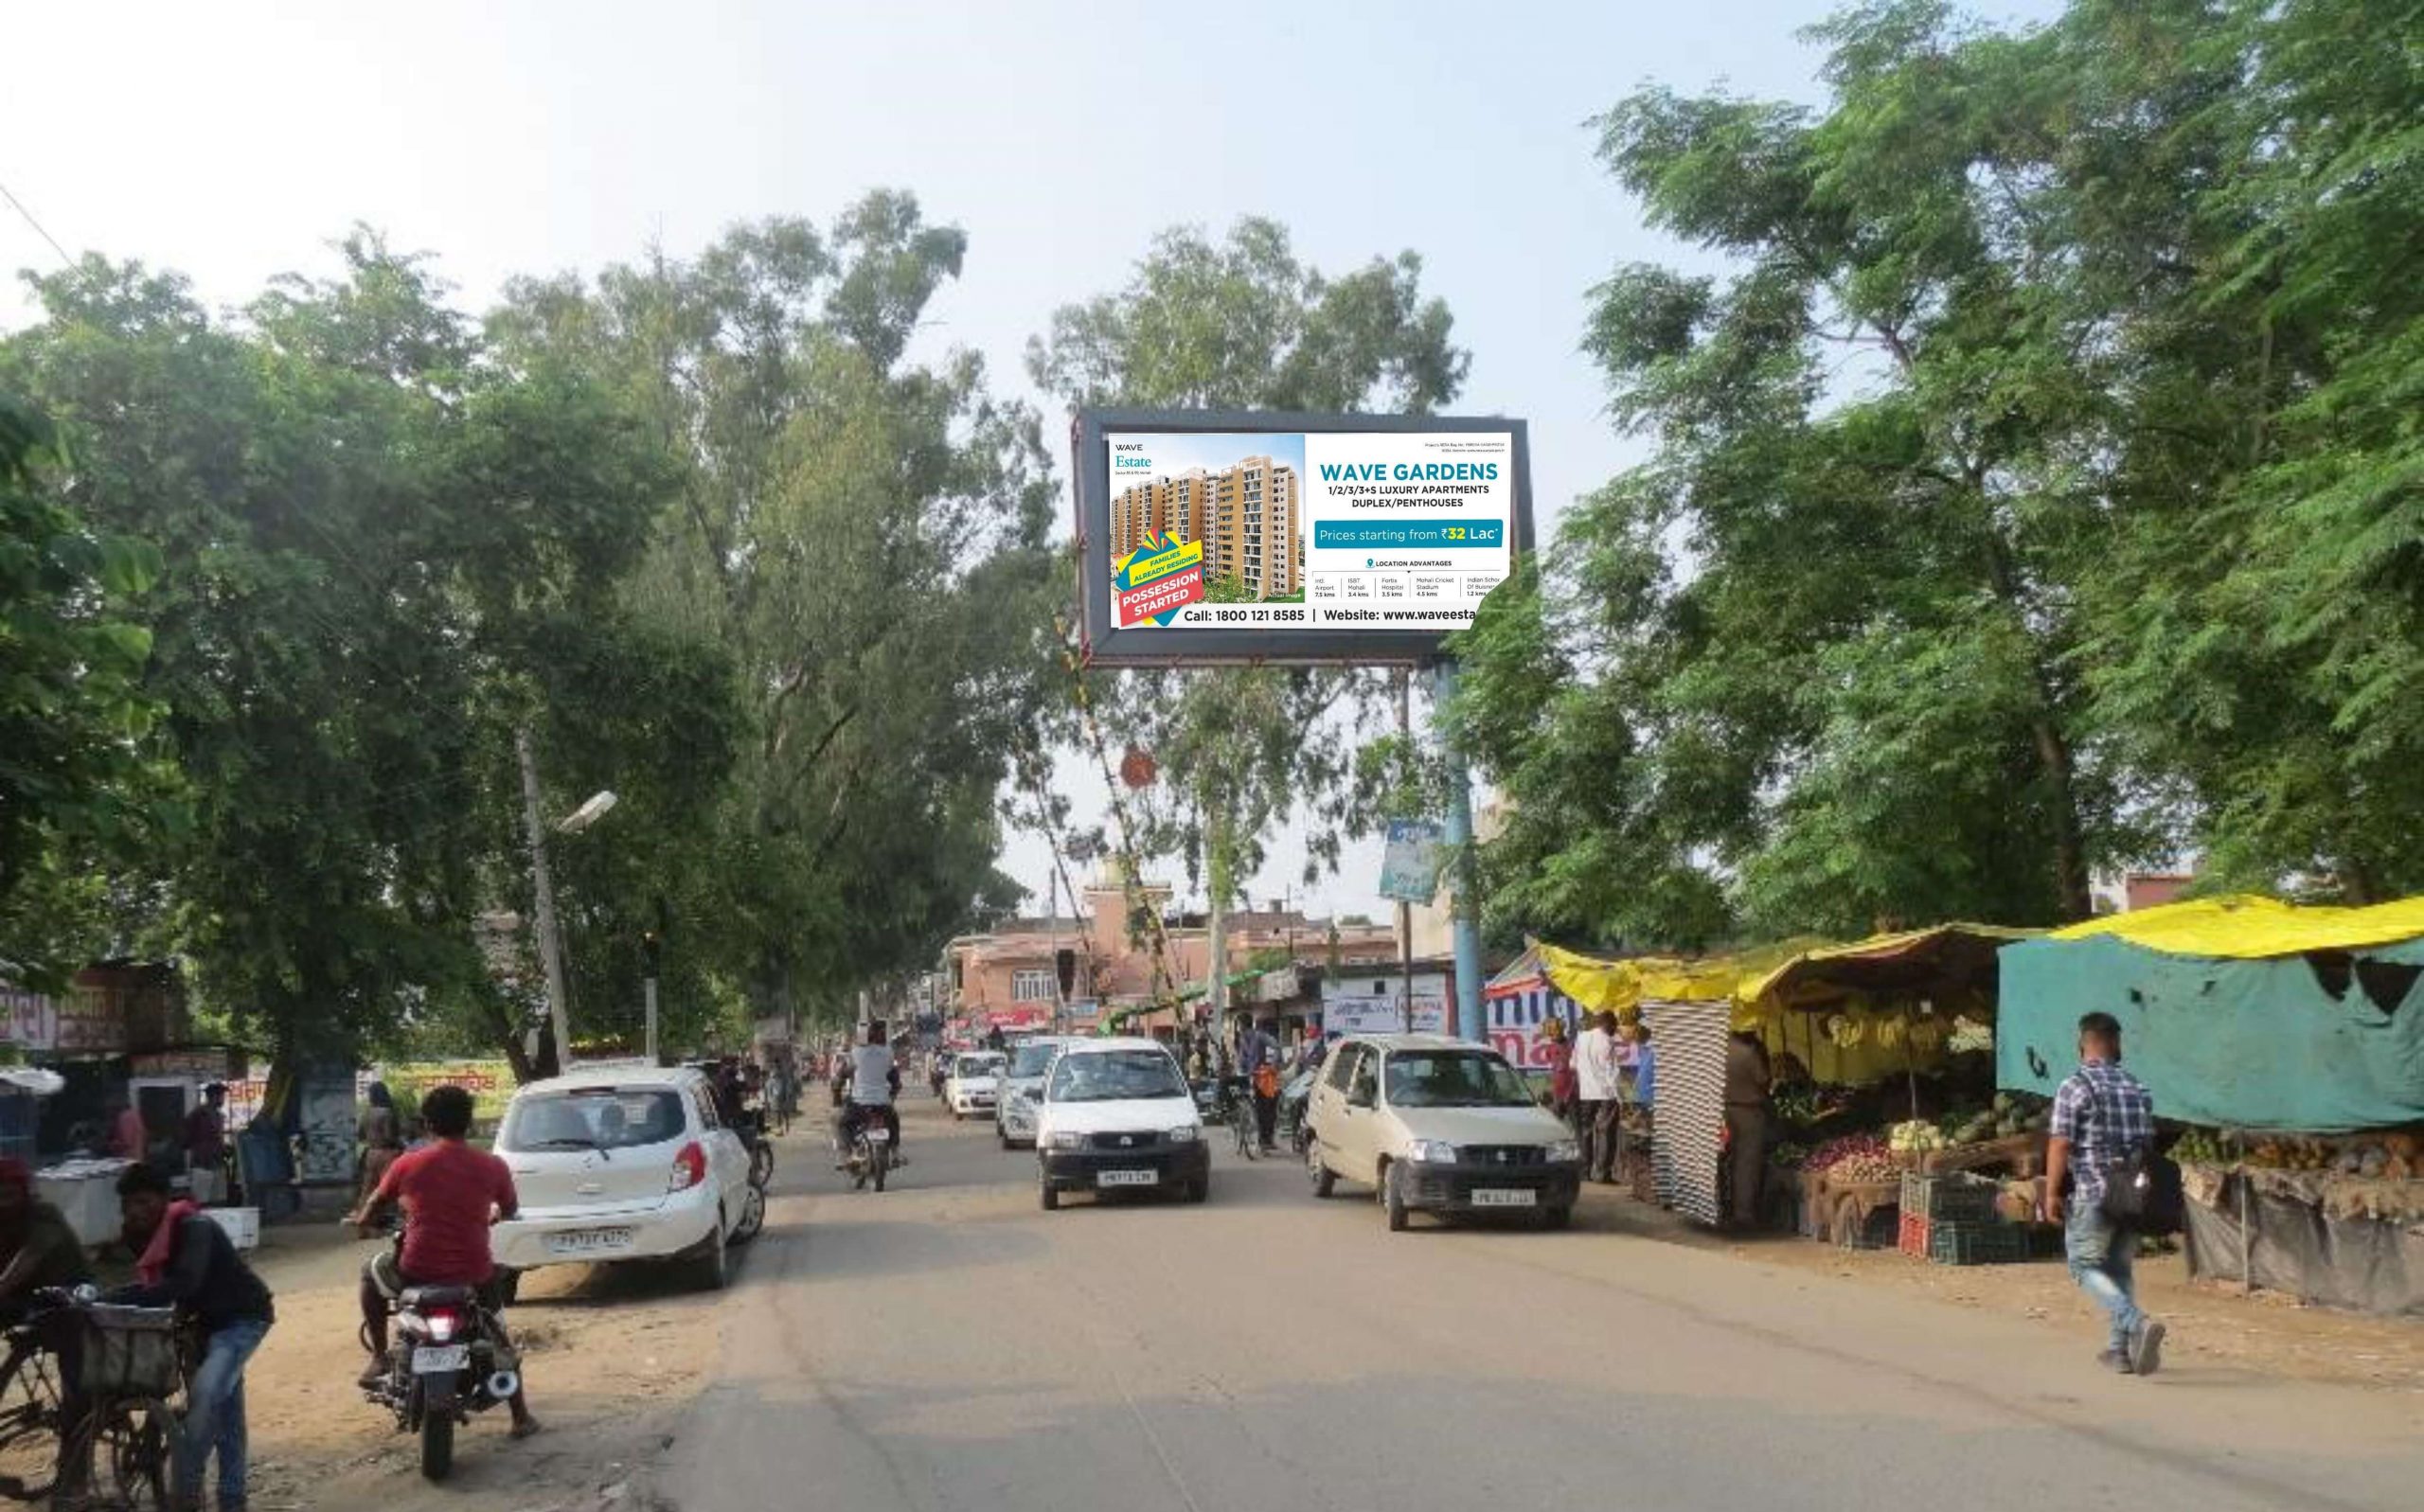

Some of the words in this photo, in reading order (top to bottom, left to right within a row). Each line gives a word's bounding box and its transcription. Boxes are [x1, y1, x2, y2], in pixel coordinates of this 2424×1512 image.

[1115, 454, 1152, 468] Estate
[1320, 464, 1387, 481] WAVE
[1393, 463, 1498, 481] GARDENS
[1328, 485, 1377, 496] 1/2/3/3+S
[1379, 485, 1419, 494] LUXURY
[1421, 485, 1489, 494] APARTMENTS
[1351, 498, 1464, 508] DUPLEX/PENTHOUSES
[1320, 529, 1356, 541] Prices
[1359, 528, 1405, 543] starting
[1409, 528, 1437, 540] from
[1150, 550, 1181, 567] FAMILIES
[1133, 565, 1166, 582] ALREADY
[1167, 553, 1199, 570] RESIDING
[1122, 571, 1199, 608] POSSESSION
[1133, 589, 1189, 616] STARTED
[1184, 610, 1212, 621] Call:
[1216, 610, 1247, 621] 1800
[1252, 610, 1270, 621] 121
[1274, 610, 1305, 621] 8585
[1324, 609, 1380, 621] Website:
